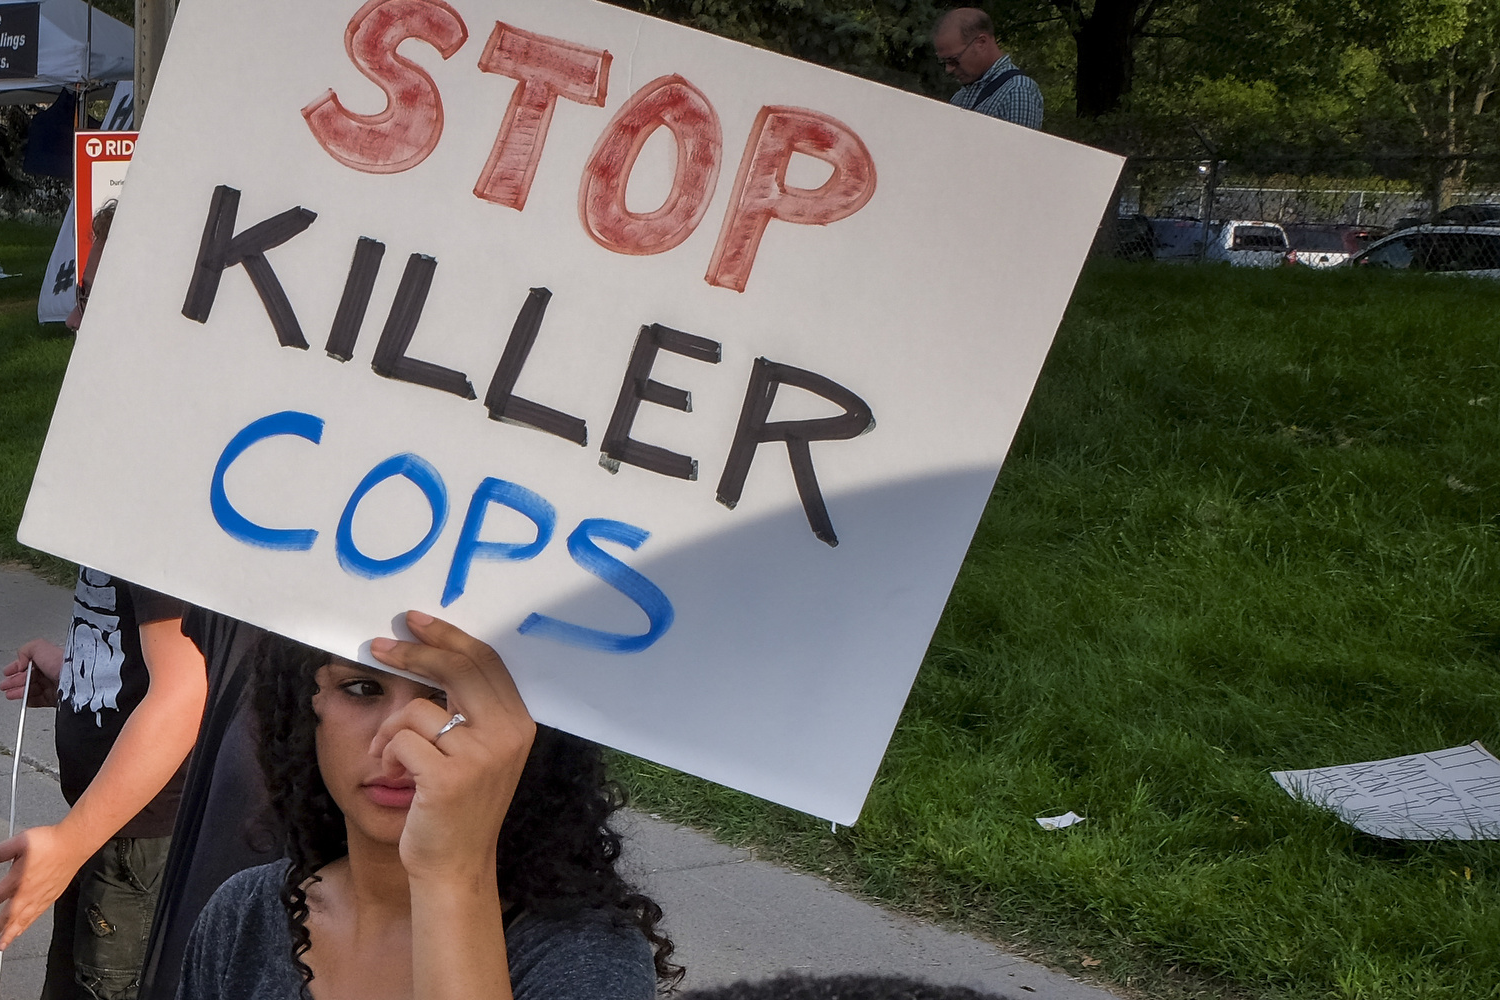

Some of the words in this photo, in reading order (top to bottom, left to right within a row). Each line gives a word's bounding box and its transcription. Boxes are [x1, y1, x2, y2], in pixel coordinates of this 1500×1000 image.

[105, 140, 137, 156] RID
[301, 0, 877, 293] STOP
[182, 184, 875, 547] KILLER
[210, 410, 674, 655] COPS
